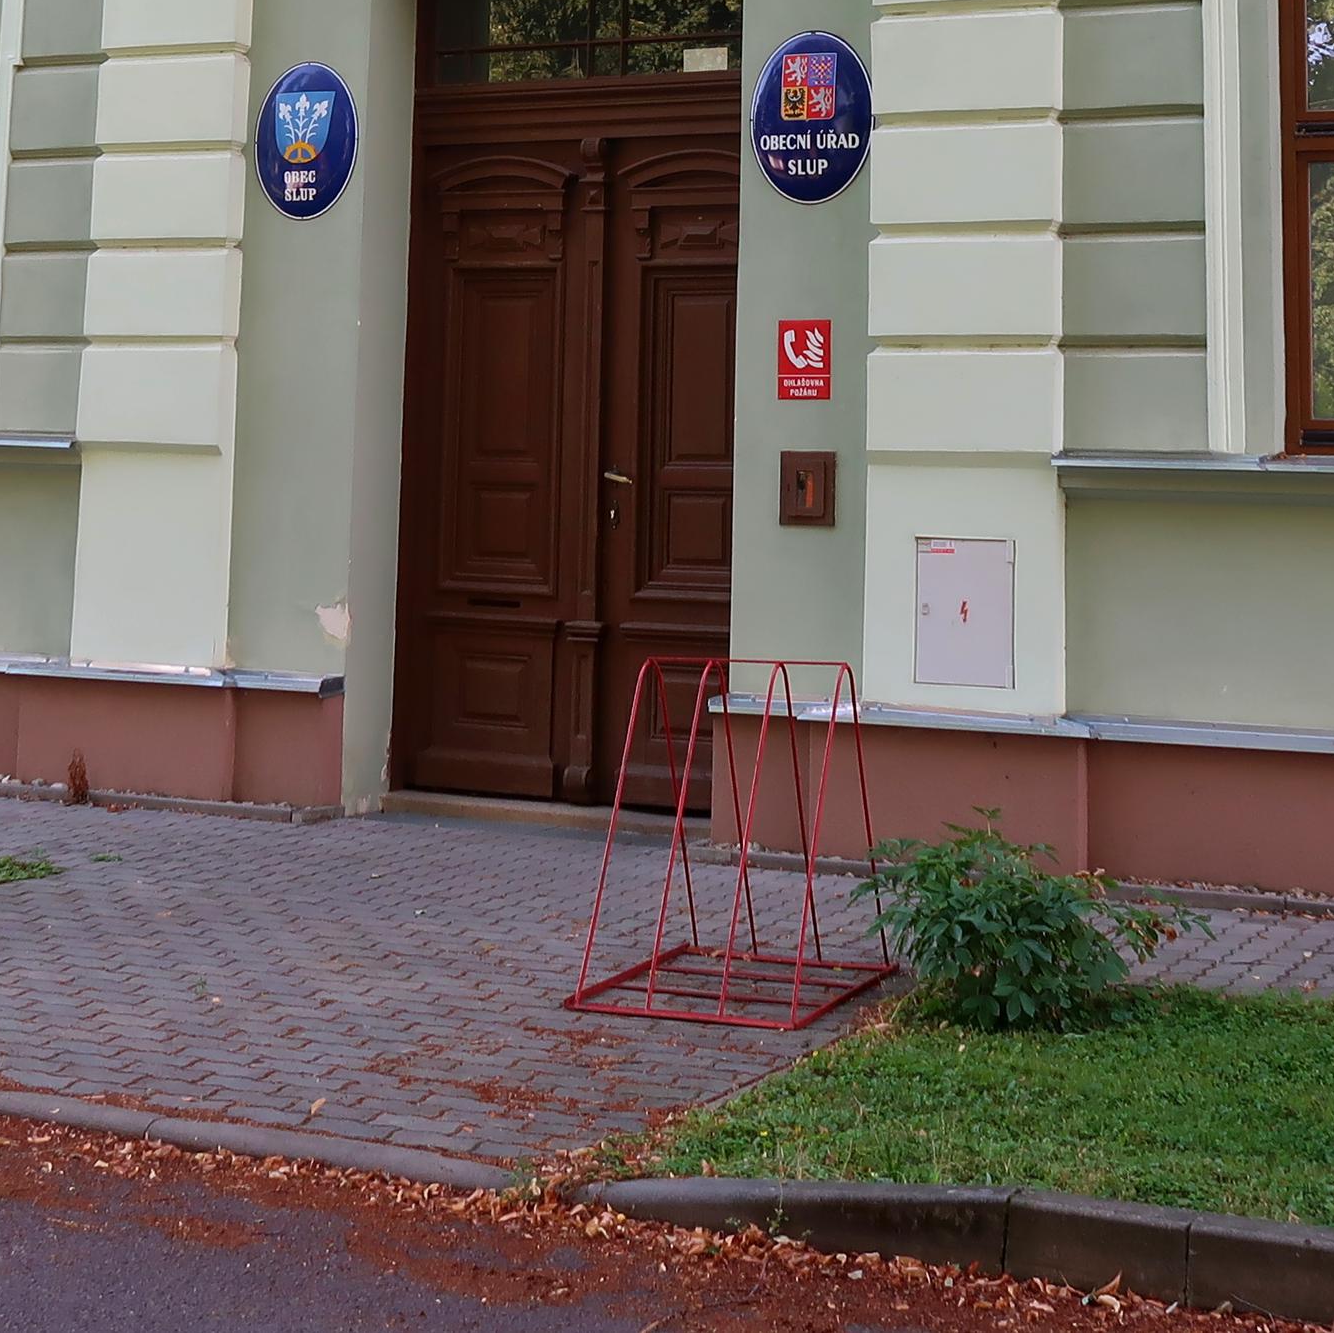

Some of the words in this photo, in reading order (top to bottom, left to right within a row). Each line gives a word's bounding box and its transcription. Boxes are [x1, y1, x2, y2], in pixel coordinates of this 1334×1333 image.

[760, 130, 811, 150] OBECNÍ
[816, 129, 860, 149] ÚŘAD
[788, 159, 828, 175] SLUP
[284, 170, 316, 183] OBEC
[284, 188, 316, 201] SLUP
[783, 378, 824, 387] OHLAŠOVNA
[790, 387, 817, 396] POŽÁRU
